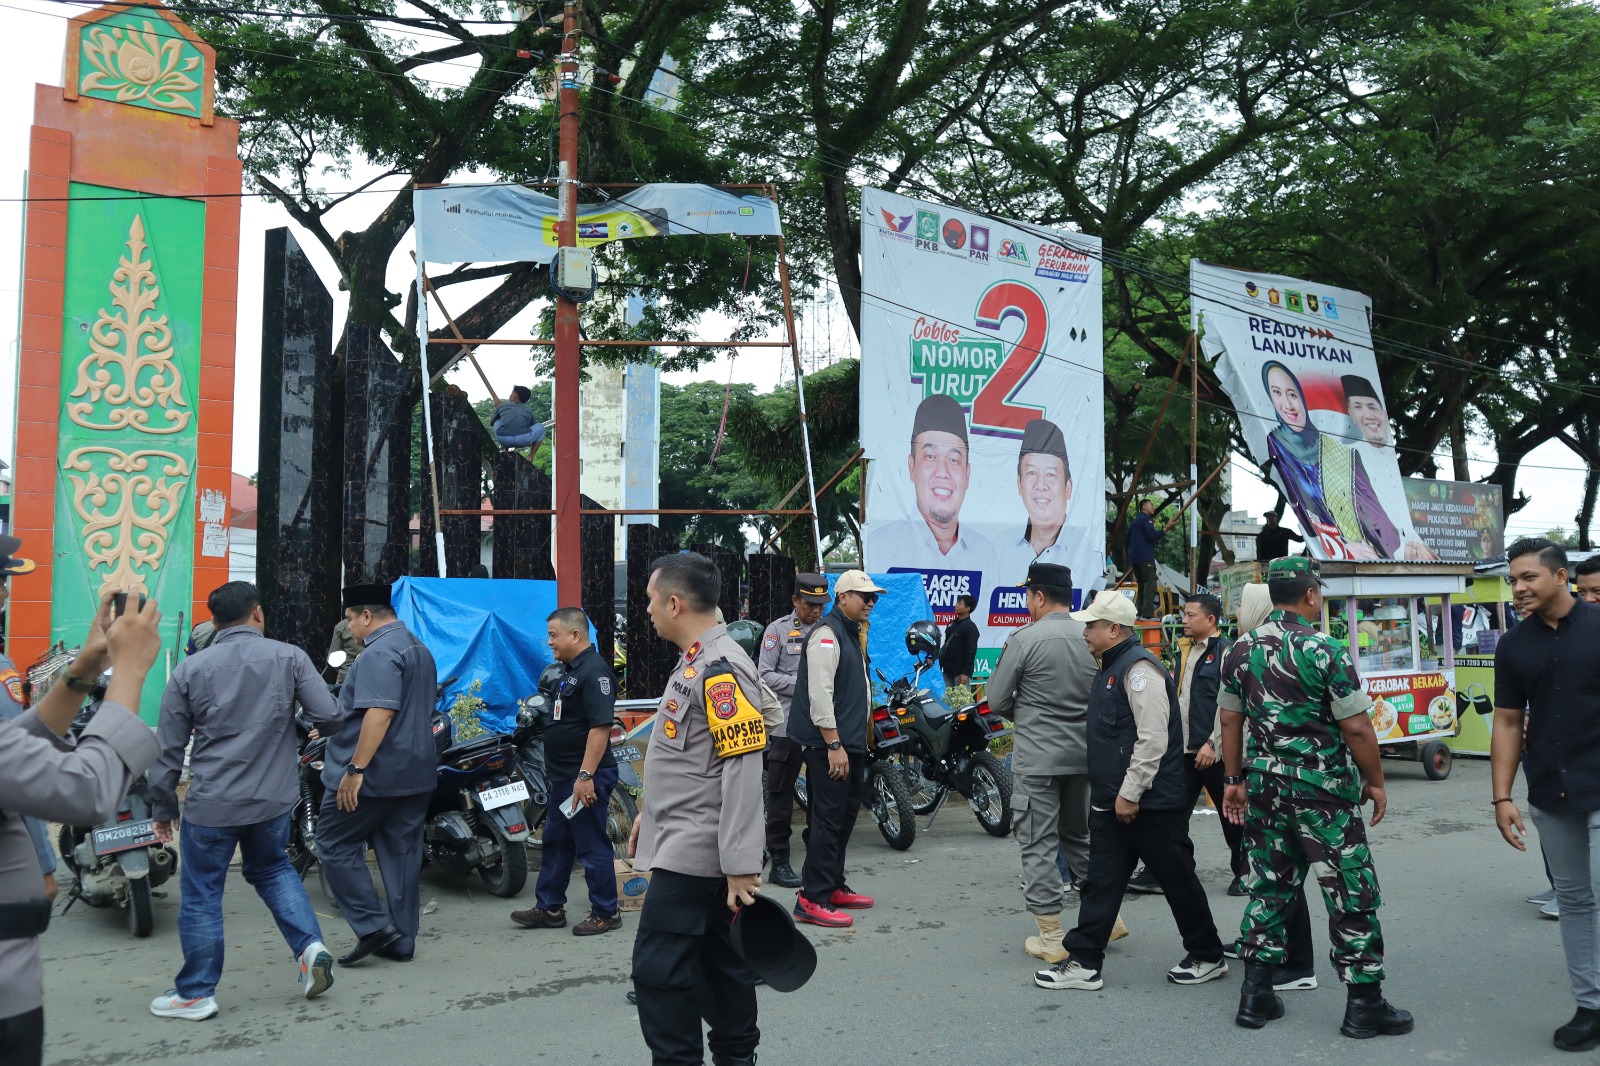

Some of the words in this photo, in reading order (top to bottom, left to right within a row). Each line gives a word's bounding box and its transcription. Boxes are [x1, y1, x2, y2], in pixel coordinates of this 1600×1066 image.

[915, 239, 939, 252] PKB
[1038, 244, 1090, 262] GERAKAN
[969, 250, 989, 261] PAN
[1038, 258, 1090, 274] PERUBAHAN
[913, 316, 960, 344] Coblos
[1248, 316, 1307, 340] READY
[921, 344, 998, 370] NOMOR
[970, 280, 1050, 436] 2
[1251, 335, 1353, 364] LANJUTKAN
[930, 373, 988, 397] URUT
[930, 574, 970, 592] AGUS
[992, 615, 1014, 624] CALON
[671, 680, 692, 697] POLRI
[1369, 677, 1411, 693] GEROBAK
[1412, 675, 1446, 690] BERKAH
[1397, 702, 1414, 711] AYAM
[726, 722, 749, 741] OPS
[747, 719, 764, 736] RES
[728, 740, 740, 750] LK
[741, 736, 761, 746] 2024
[492, 787, 511, 798] 3116
